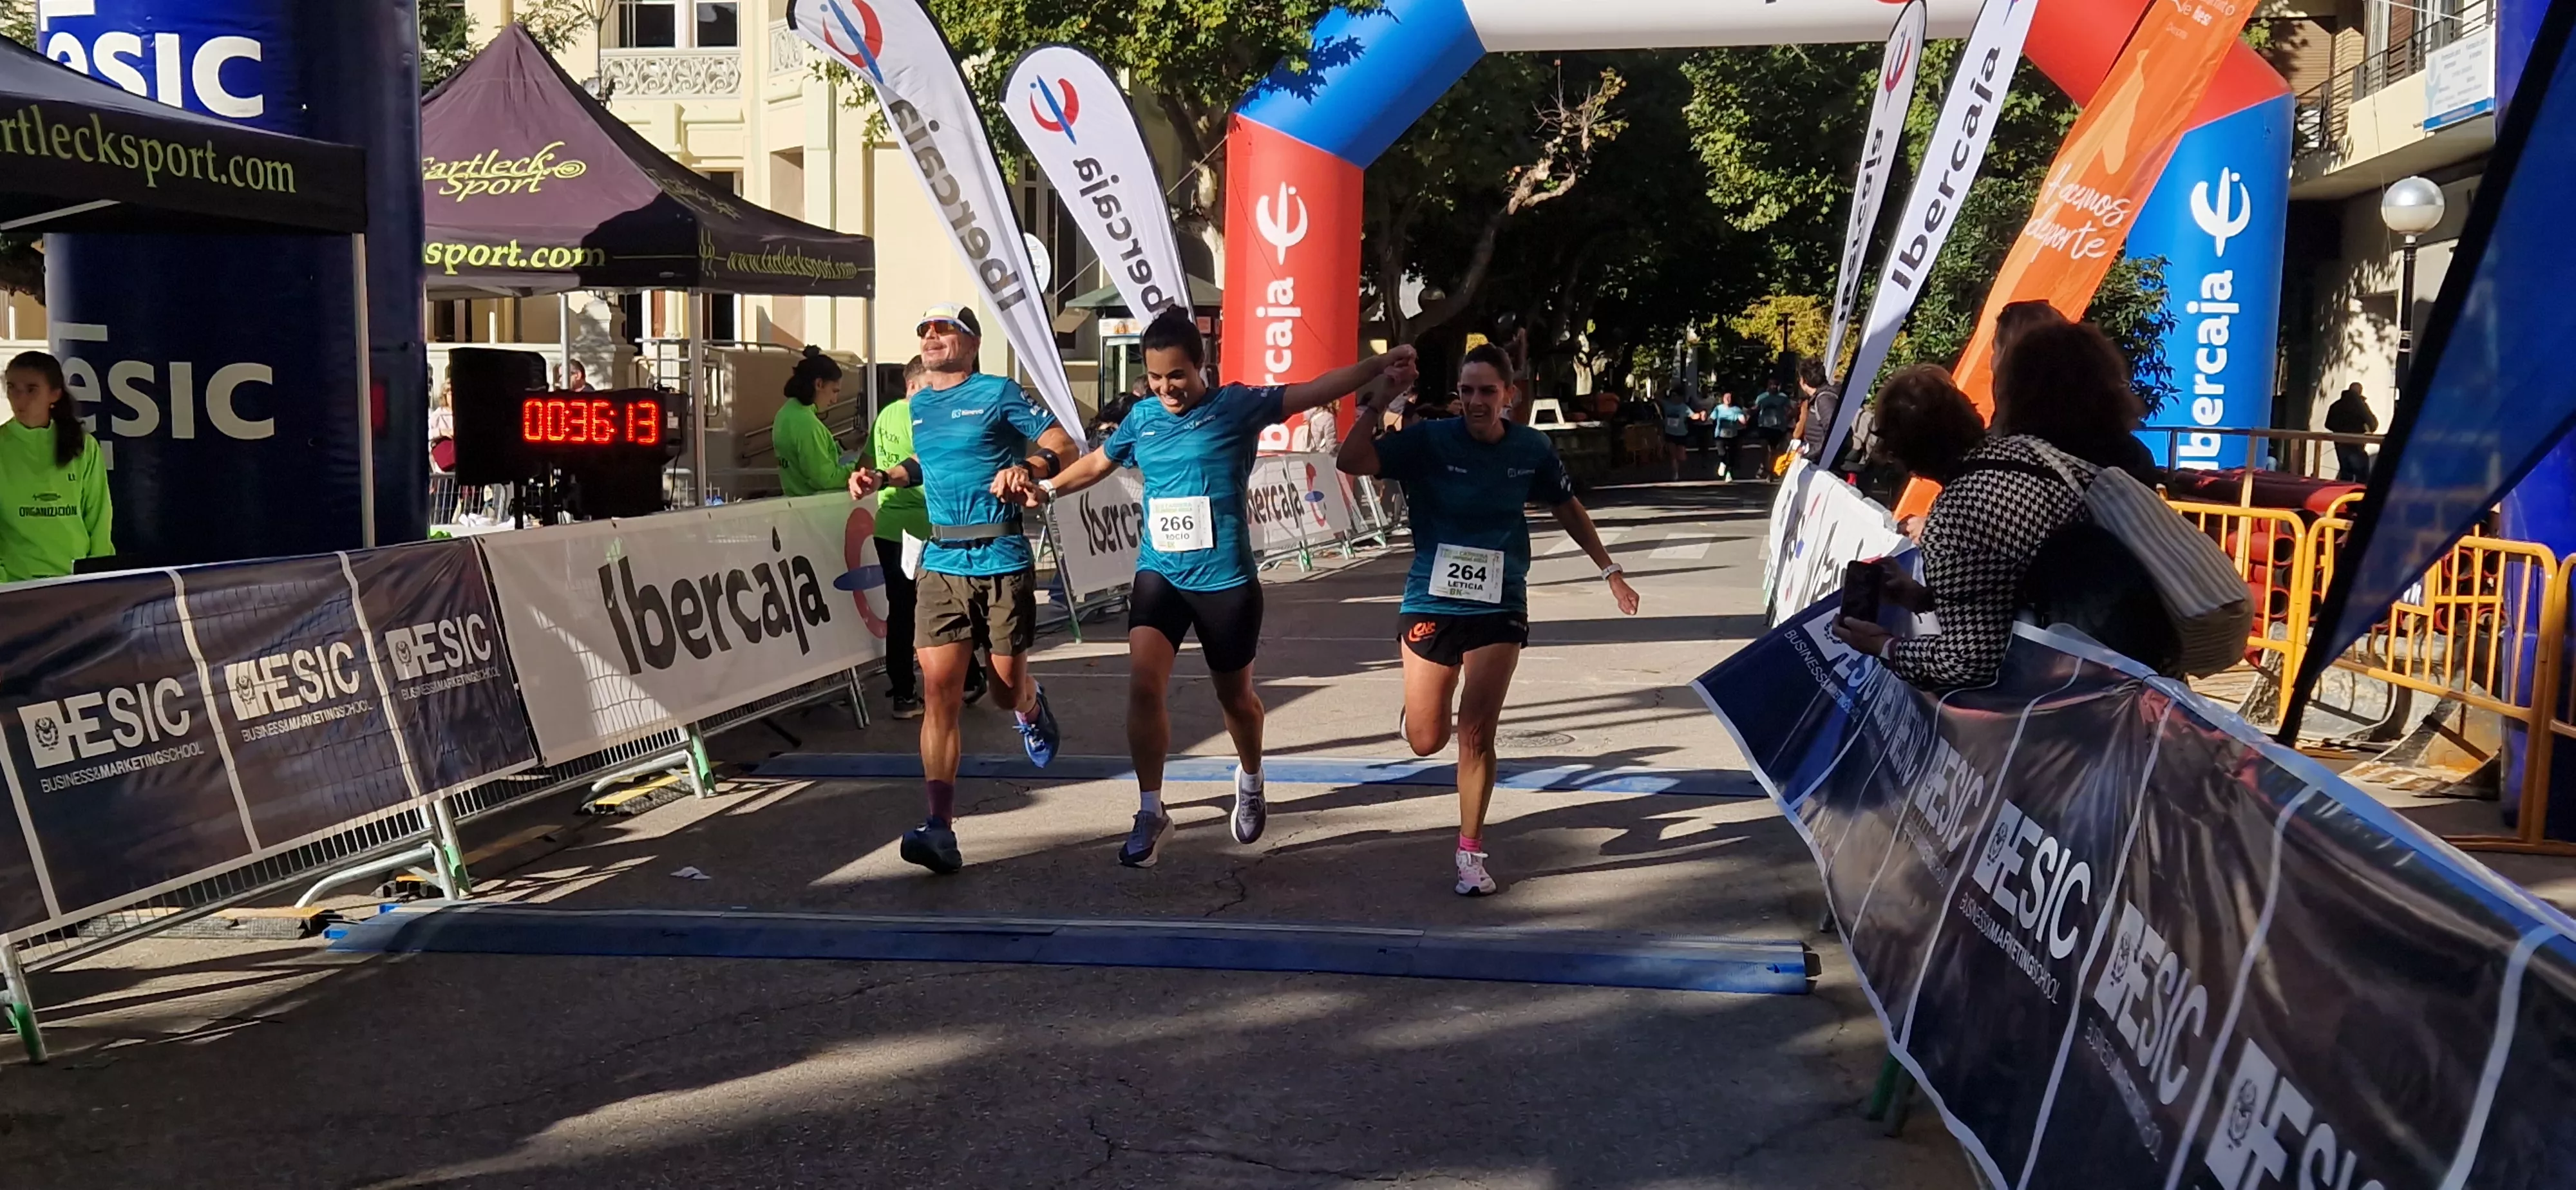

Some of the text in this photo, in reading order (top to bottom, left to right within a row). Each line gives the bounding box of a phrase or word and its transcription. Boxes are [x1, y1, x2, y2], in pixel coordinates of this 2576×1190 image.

[0, 104, 296, 193] rtlecksport.com
[1891, 46, 2001, 292] Ibercaja
[439, 171, 546, 202] Sport
[2043, 163, 2131, 227] Hacemos
[2025, 202, 2110, 263] deporte
[2179, 269, 2240, 471] Ibercaja
[1079, 491, 1144, 556] Iberca
[1160, 515, 1194, 532] 266
[598, 525, 831, 675] Ibercaja
[1447, 562, 1487, 583] 264
[1448, 580, 1484, 591] LETICIA
[259, 642, 360, 713] ESIC
[415, 614, 491, 681] ESIC
[63, 677, 191, 759] ESIC
[1925, 746, 1984, 853] ESIC
[1992, 815, 2091, 959] ESIC
[2117, 923, 2208, 1106] ESIC
